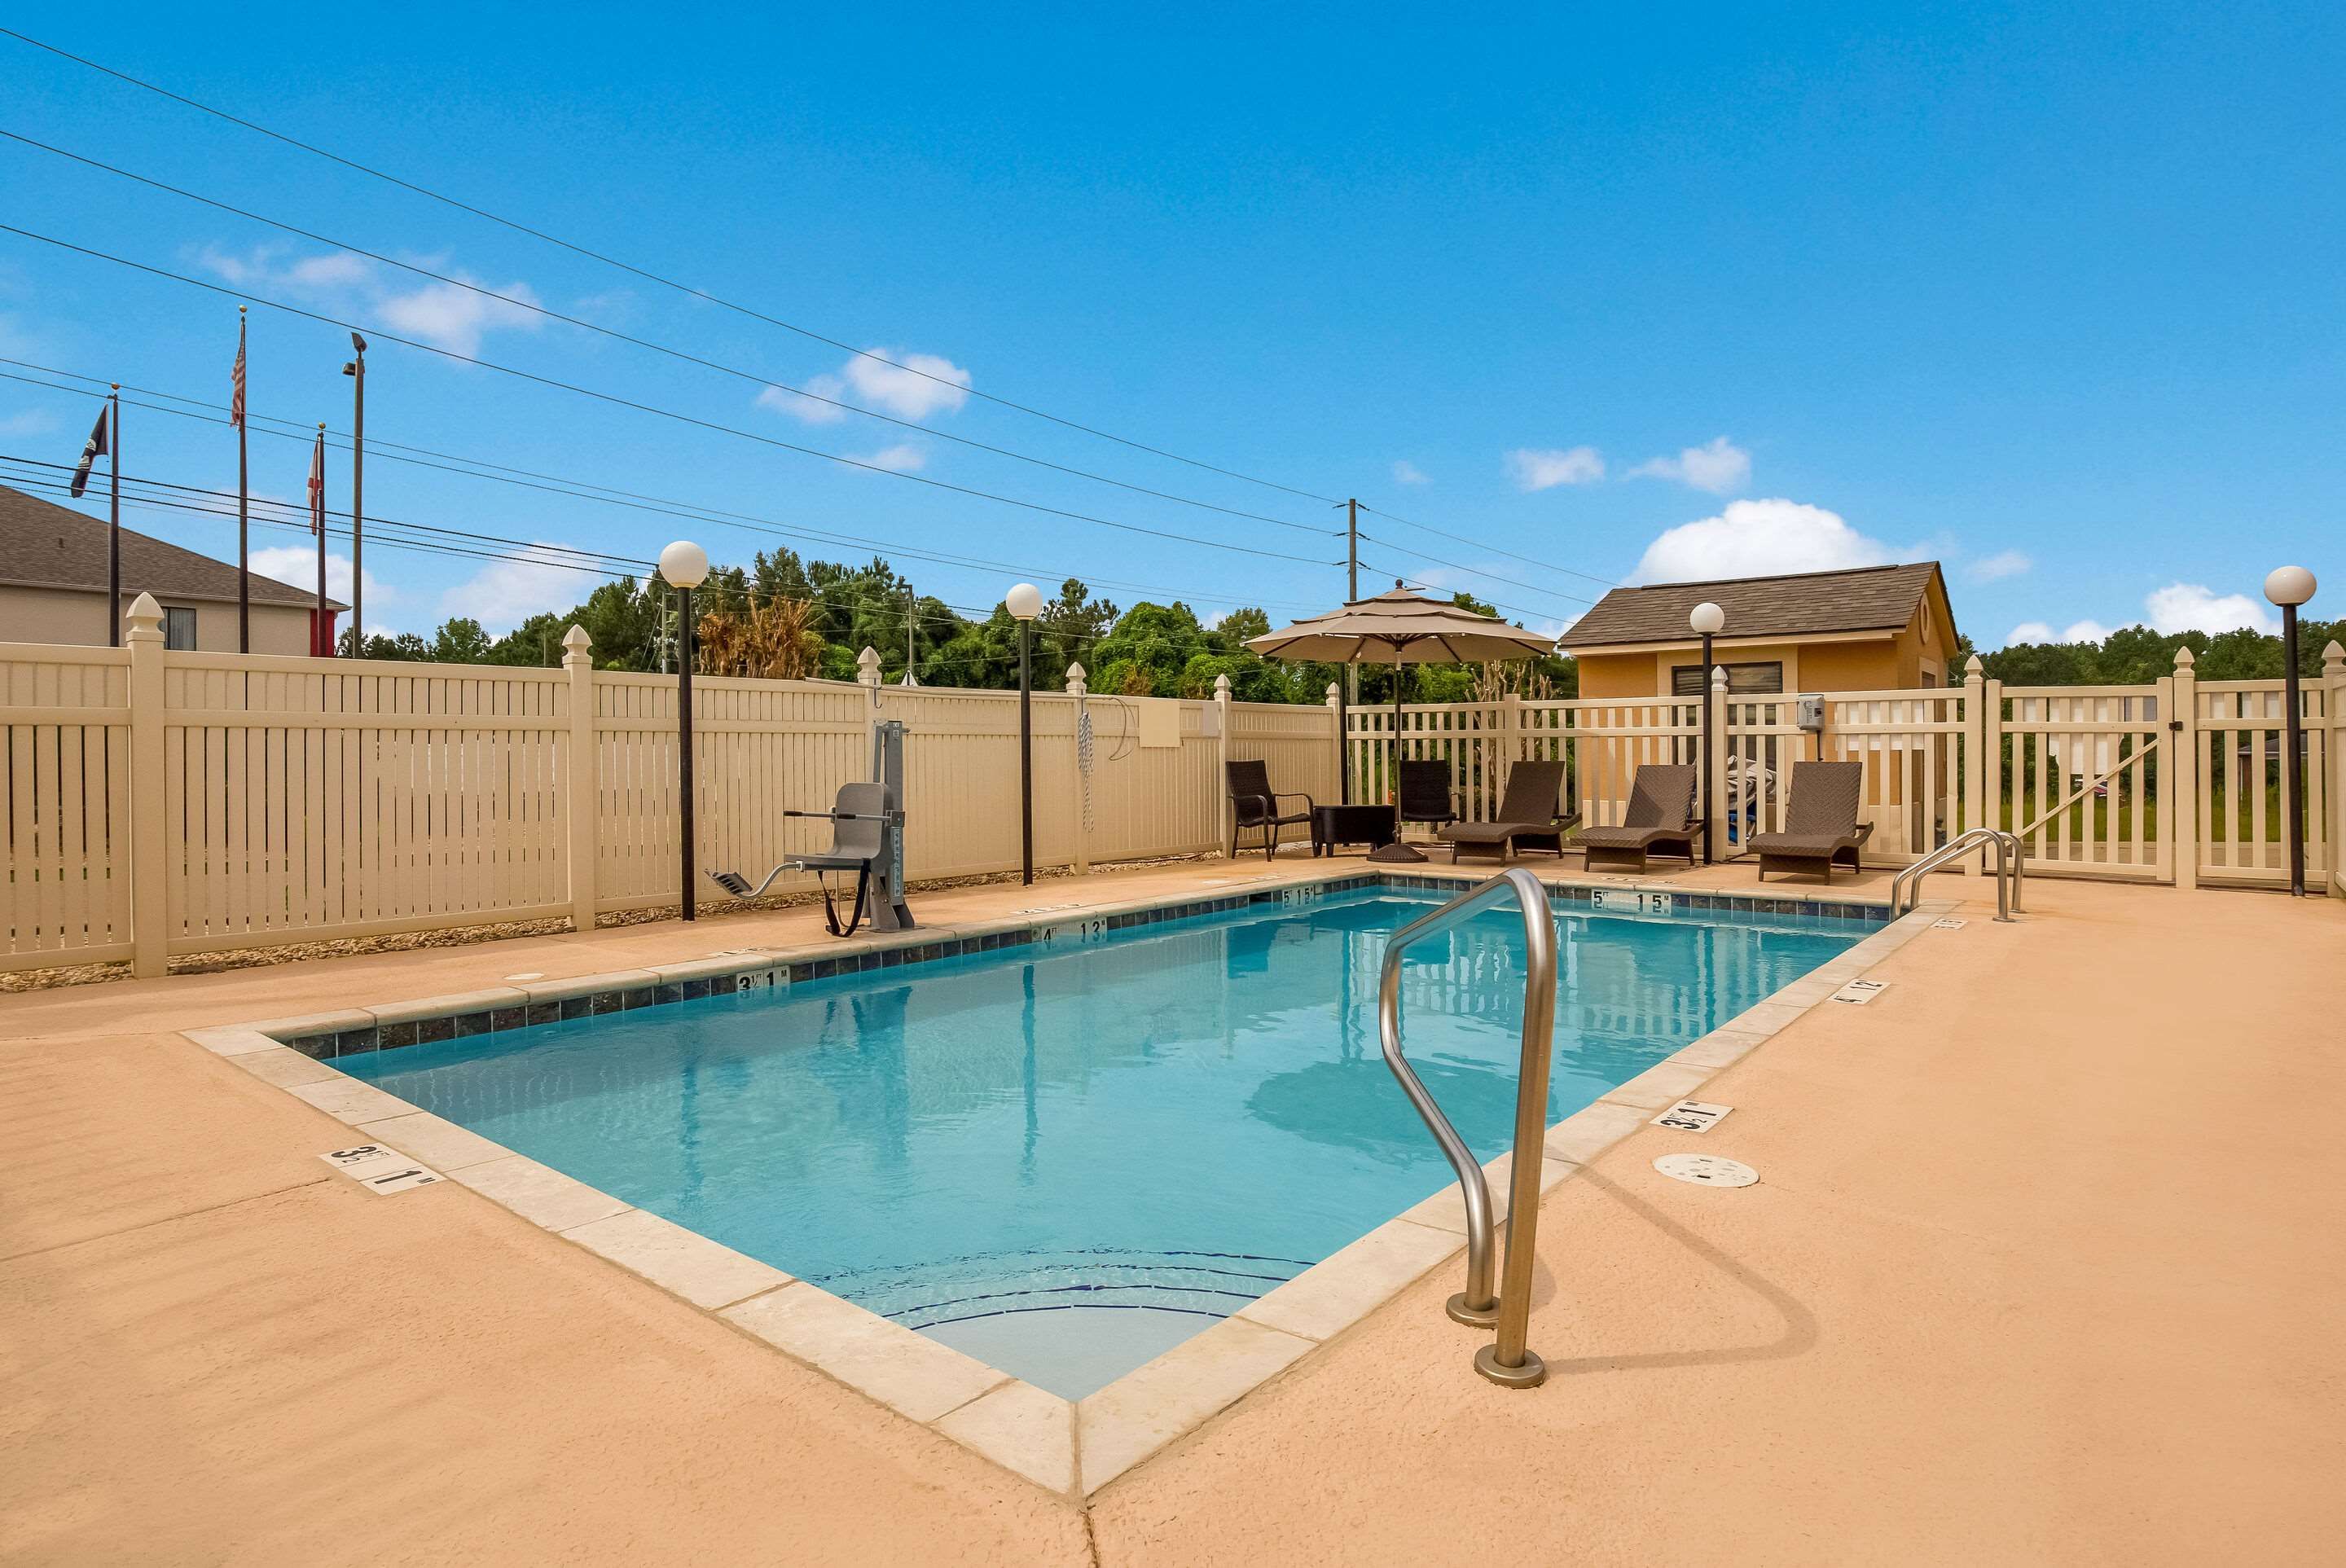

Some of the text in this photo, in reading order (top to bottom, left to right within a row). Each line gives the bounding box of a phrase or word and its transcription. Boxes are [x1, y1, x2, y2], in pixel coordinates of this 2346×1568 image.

[1593, 891, 1603, 903] 5
[739, 976, 751, 991] 3
[767, 971, 774, 986] 1
[781, 969, 788, 978] M
[1677, 1108, 1717, 1117] 1
[1660, 1119, 1701, 1130] 3
[331, 1145, 377, 1158] 3
[373, 1170, 423, 1185] 1
